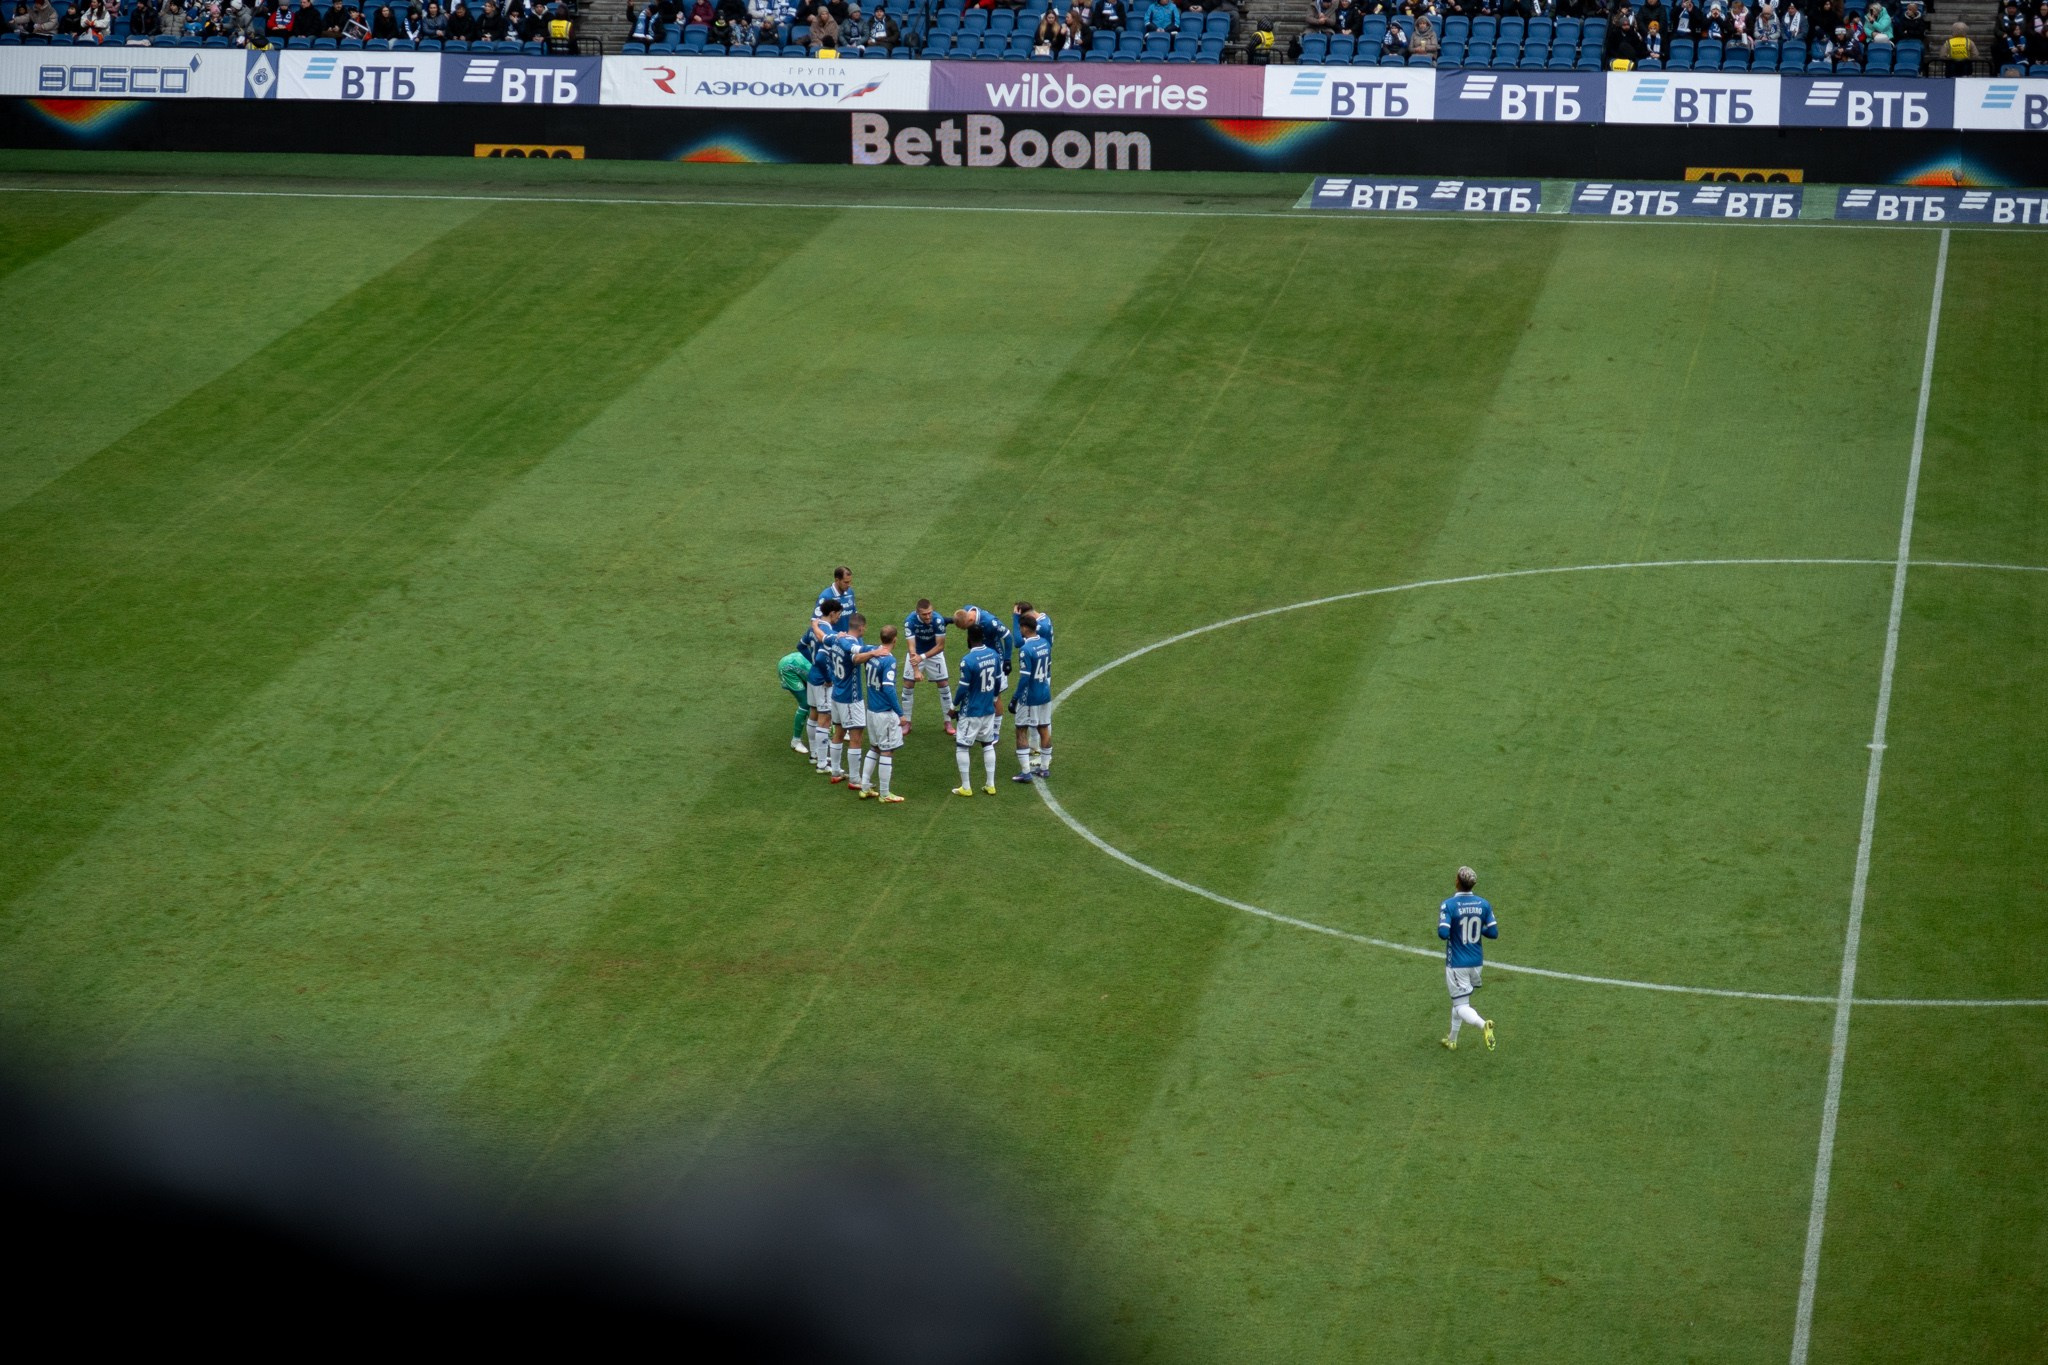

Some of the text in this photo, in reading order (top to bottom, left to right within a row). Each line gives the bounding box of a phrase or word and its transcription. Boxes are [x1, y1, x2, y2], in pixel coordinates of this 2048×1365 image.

[38, 64, 191, 93] BOSCO
[341, 65, 416, 100] ВТБ
[501, 67, 578, 104] ВТБ
[788, 67, 846, 76] ГРУППА
[694, 80, 845, 98] АЭРОФЛОТ
[985, 72, 1208, 111] wildberries
[1330, 81, 1409, 117] ВТБ
[1500, 84, 1581, 121] ВТБ
[1673, 87, 1754, 124] ВТБ
[1847, 91, 1929, 128] ВТБ
[851, 111, 1152, 171] BetBoom
[1350, 184, 1419, 210] ВТБ
[1463, 187, 1532, 213] ВТБ
[1610, 189, 1680, 216] ВТБ
[1724, 192, 1794, 218] ВТБ
[1875, 195, 1946, 221] ВТБ
[979, 666, 995, 693] 13
[1459, 916, 1482, 945] 10
